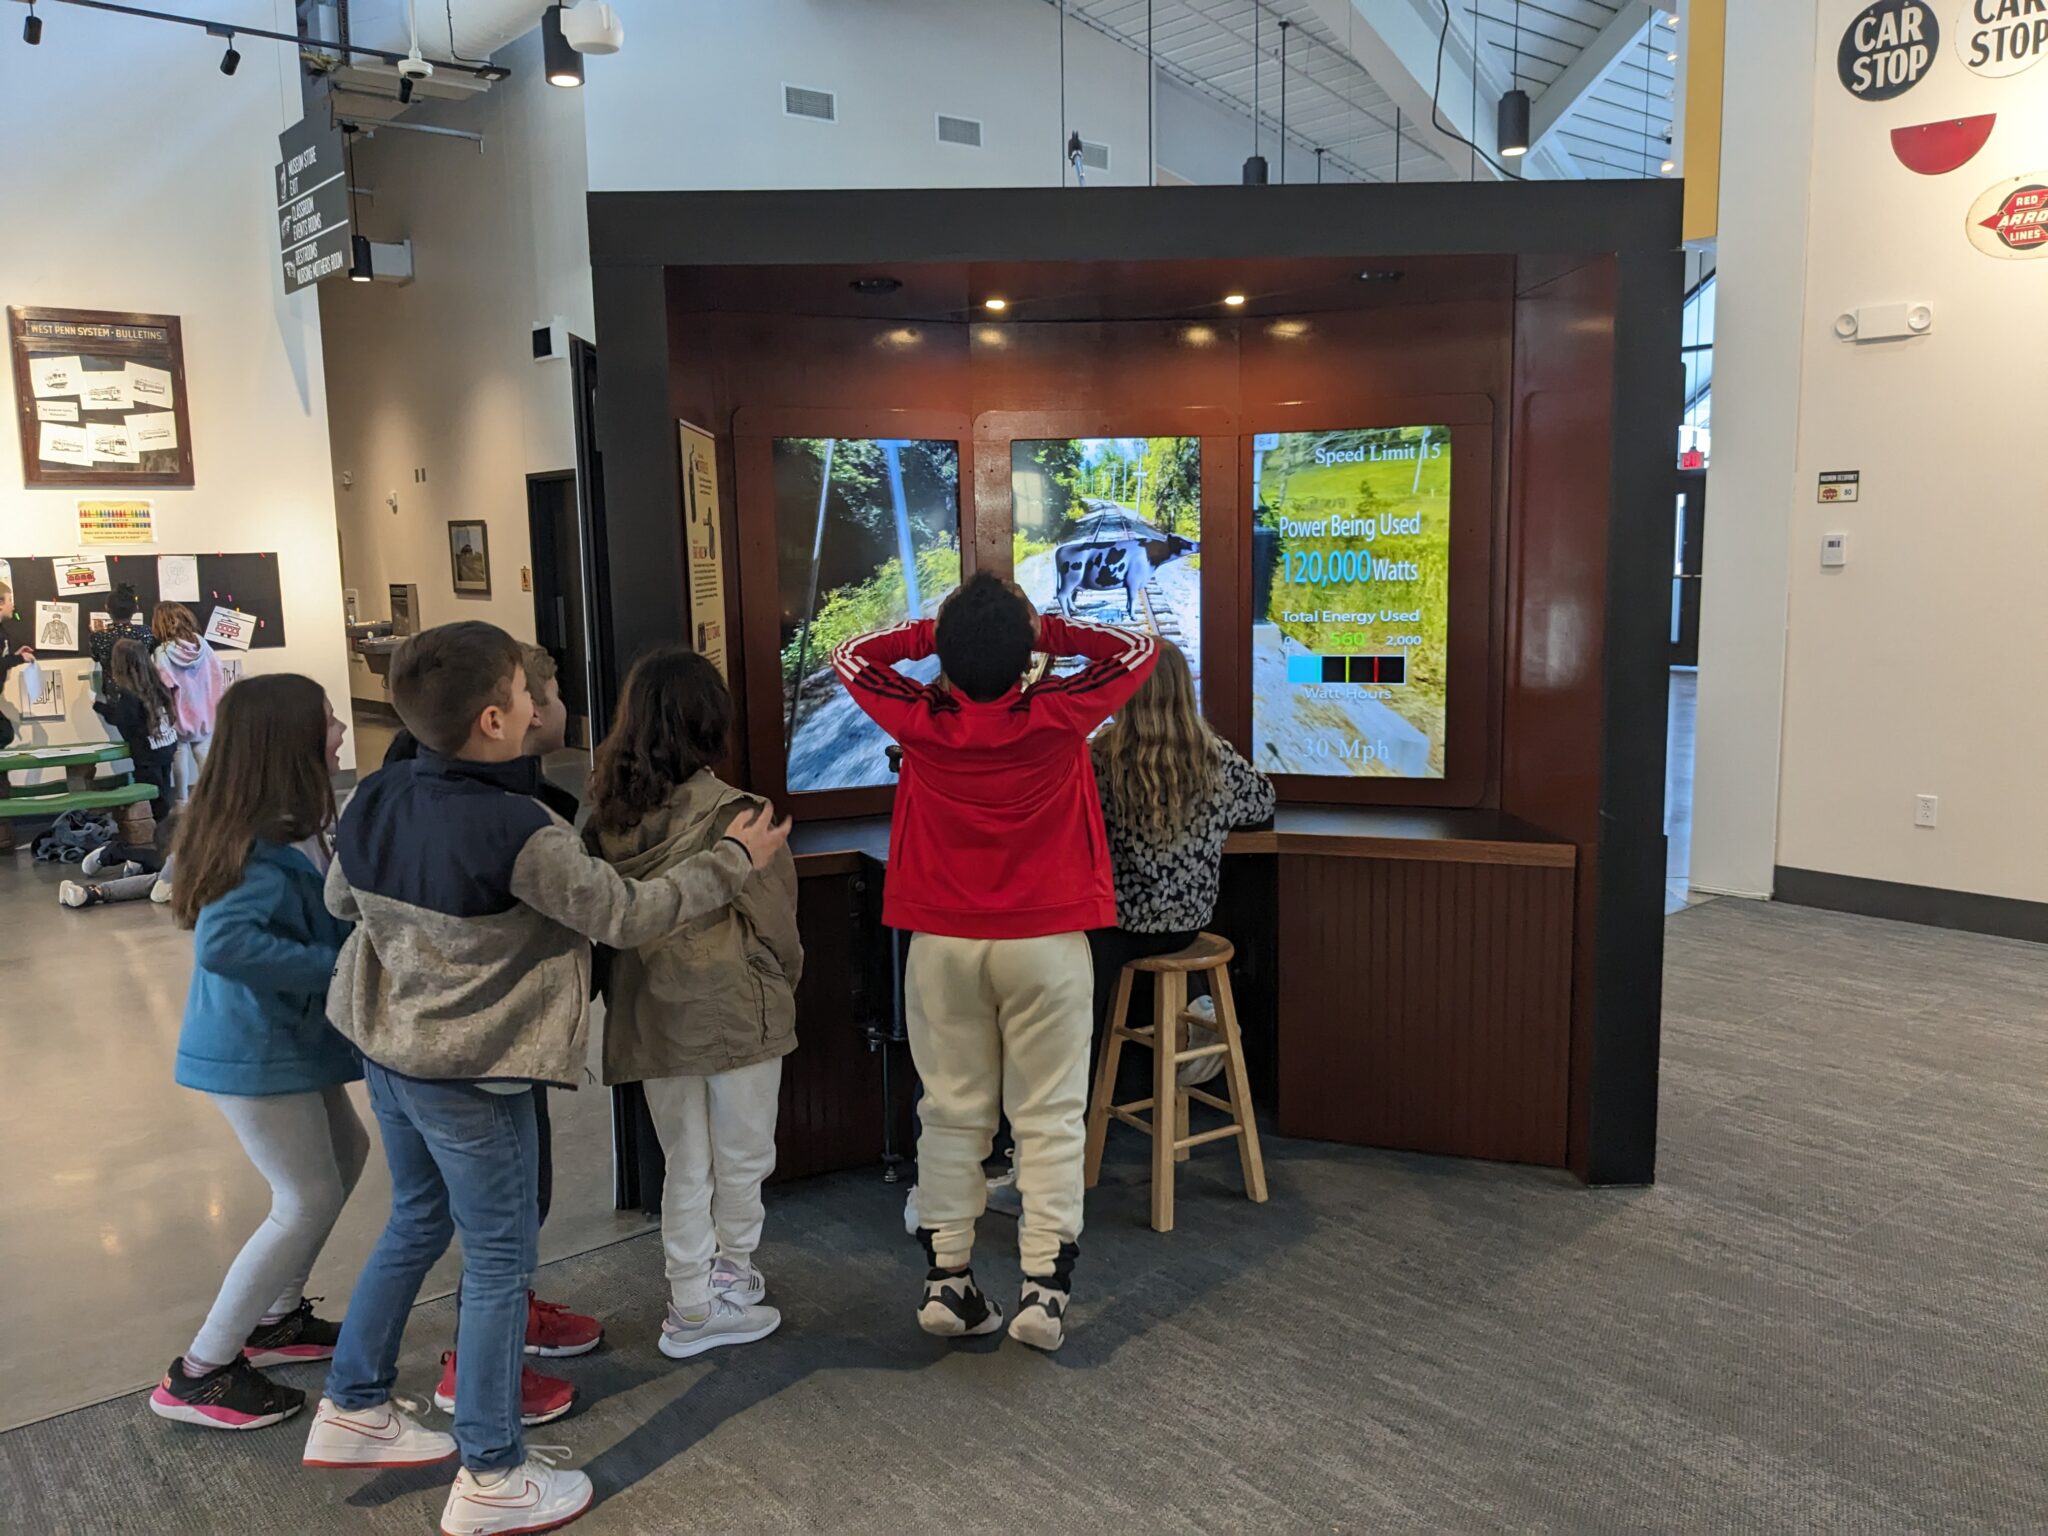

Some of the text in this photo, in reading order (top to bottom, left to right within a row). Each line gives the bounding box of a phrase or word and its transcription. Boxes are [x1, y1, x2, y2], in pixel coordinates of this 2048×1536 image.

[1854, 6, 1924, 52] CAR
[1968, 18, 2048, 67] STOP
[1851, 44, 1928, 92] STOP
[288, 146, 316, 176] MUSEUM STORE
[290, 178, 298, 196] EXIT
[292, 196, 314, 221] CLASSROOM
[2016, 195, 2038, 207] RED
[294, 212, 322, 241] EVENTS ROOMS
[2010, 229, 2041, 242] LINES
[296, 242, 318, 266] RESTROOMS
[330, 250, 344, 271] ROOM
[31, 324, 163, 341] WEST PENN SYSTEM BULLETINS
[1315, 442, 1442, 467] Speed Limit 15
[1279, 511, 1421, 541] Power Being Used
[1281, 549, 1418, 588] 120,000 Watts
[1282, 610, 1421, 624] Total Energy Used
[1284, 636, 1293, 646] 0
[1329, 631, 1366, 646] 560
[1385, 635, 1422, 647] 2,000
[1304, 687, 1392, 700] Watt Hours
[1303, 738, 1390, 763] 30 Mph
